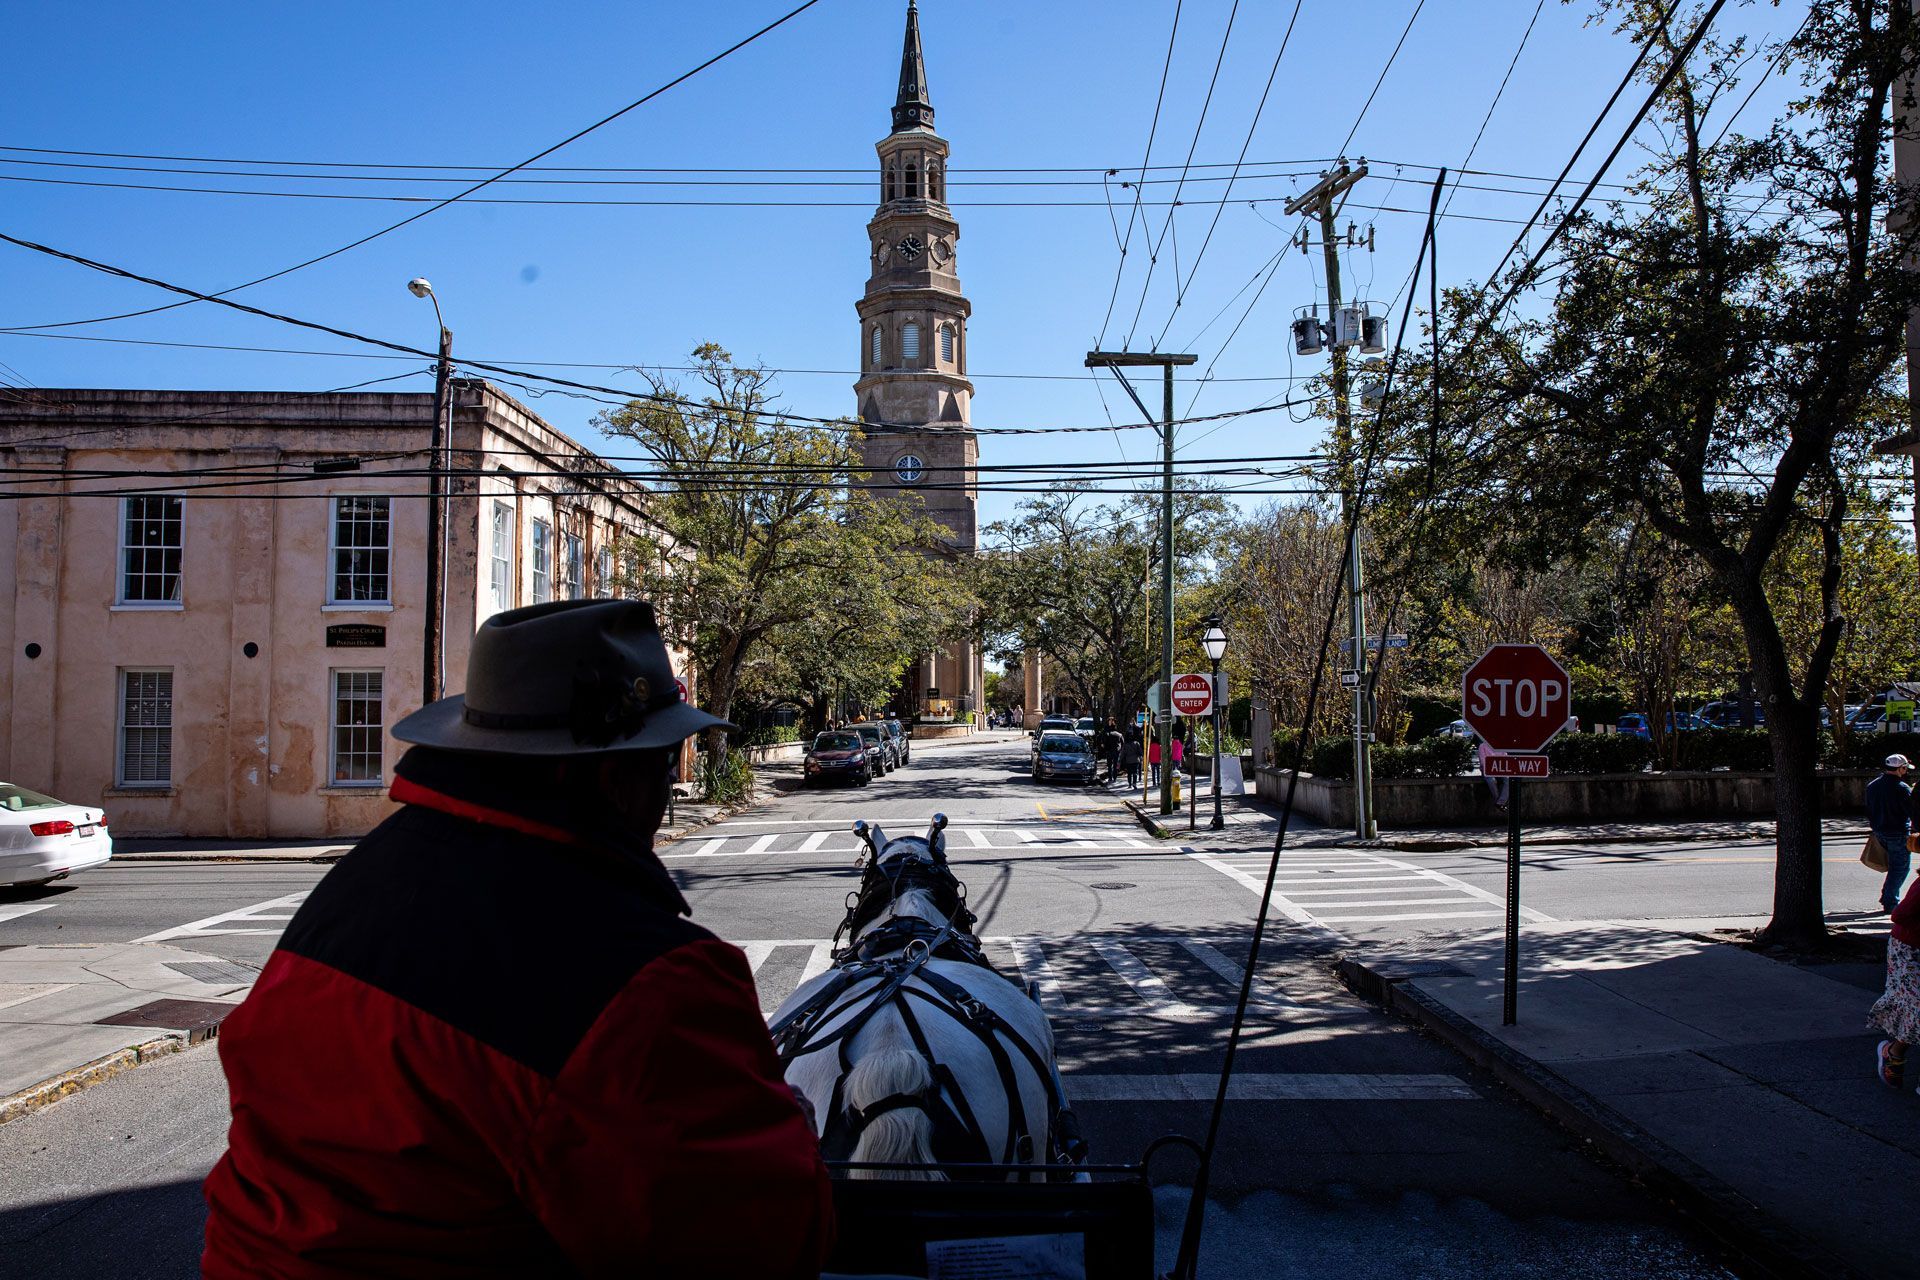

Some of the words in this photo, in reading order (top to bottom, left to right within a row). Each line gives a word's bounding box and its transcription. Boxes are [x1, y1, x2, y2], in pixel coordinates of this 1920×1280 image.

[1177, 682, 1188, 690] DO
[1190, 682, 1206, 690] NOT
[1180, 699, 1203, 707] ENTER
[1470, 678, 1563, 718] STOP
[1491, 760, 1512, 773] ALL
[1518, 760, 1542, 773] WAY
